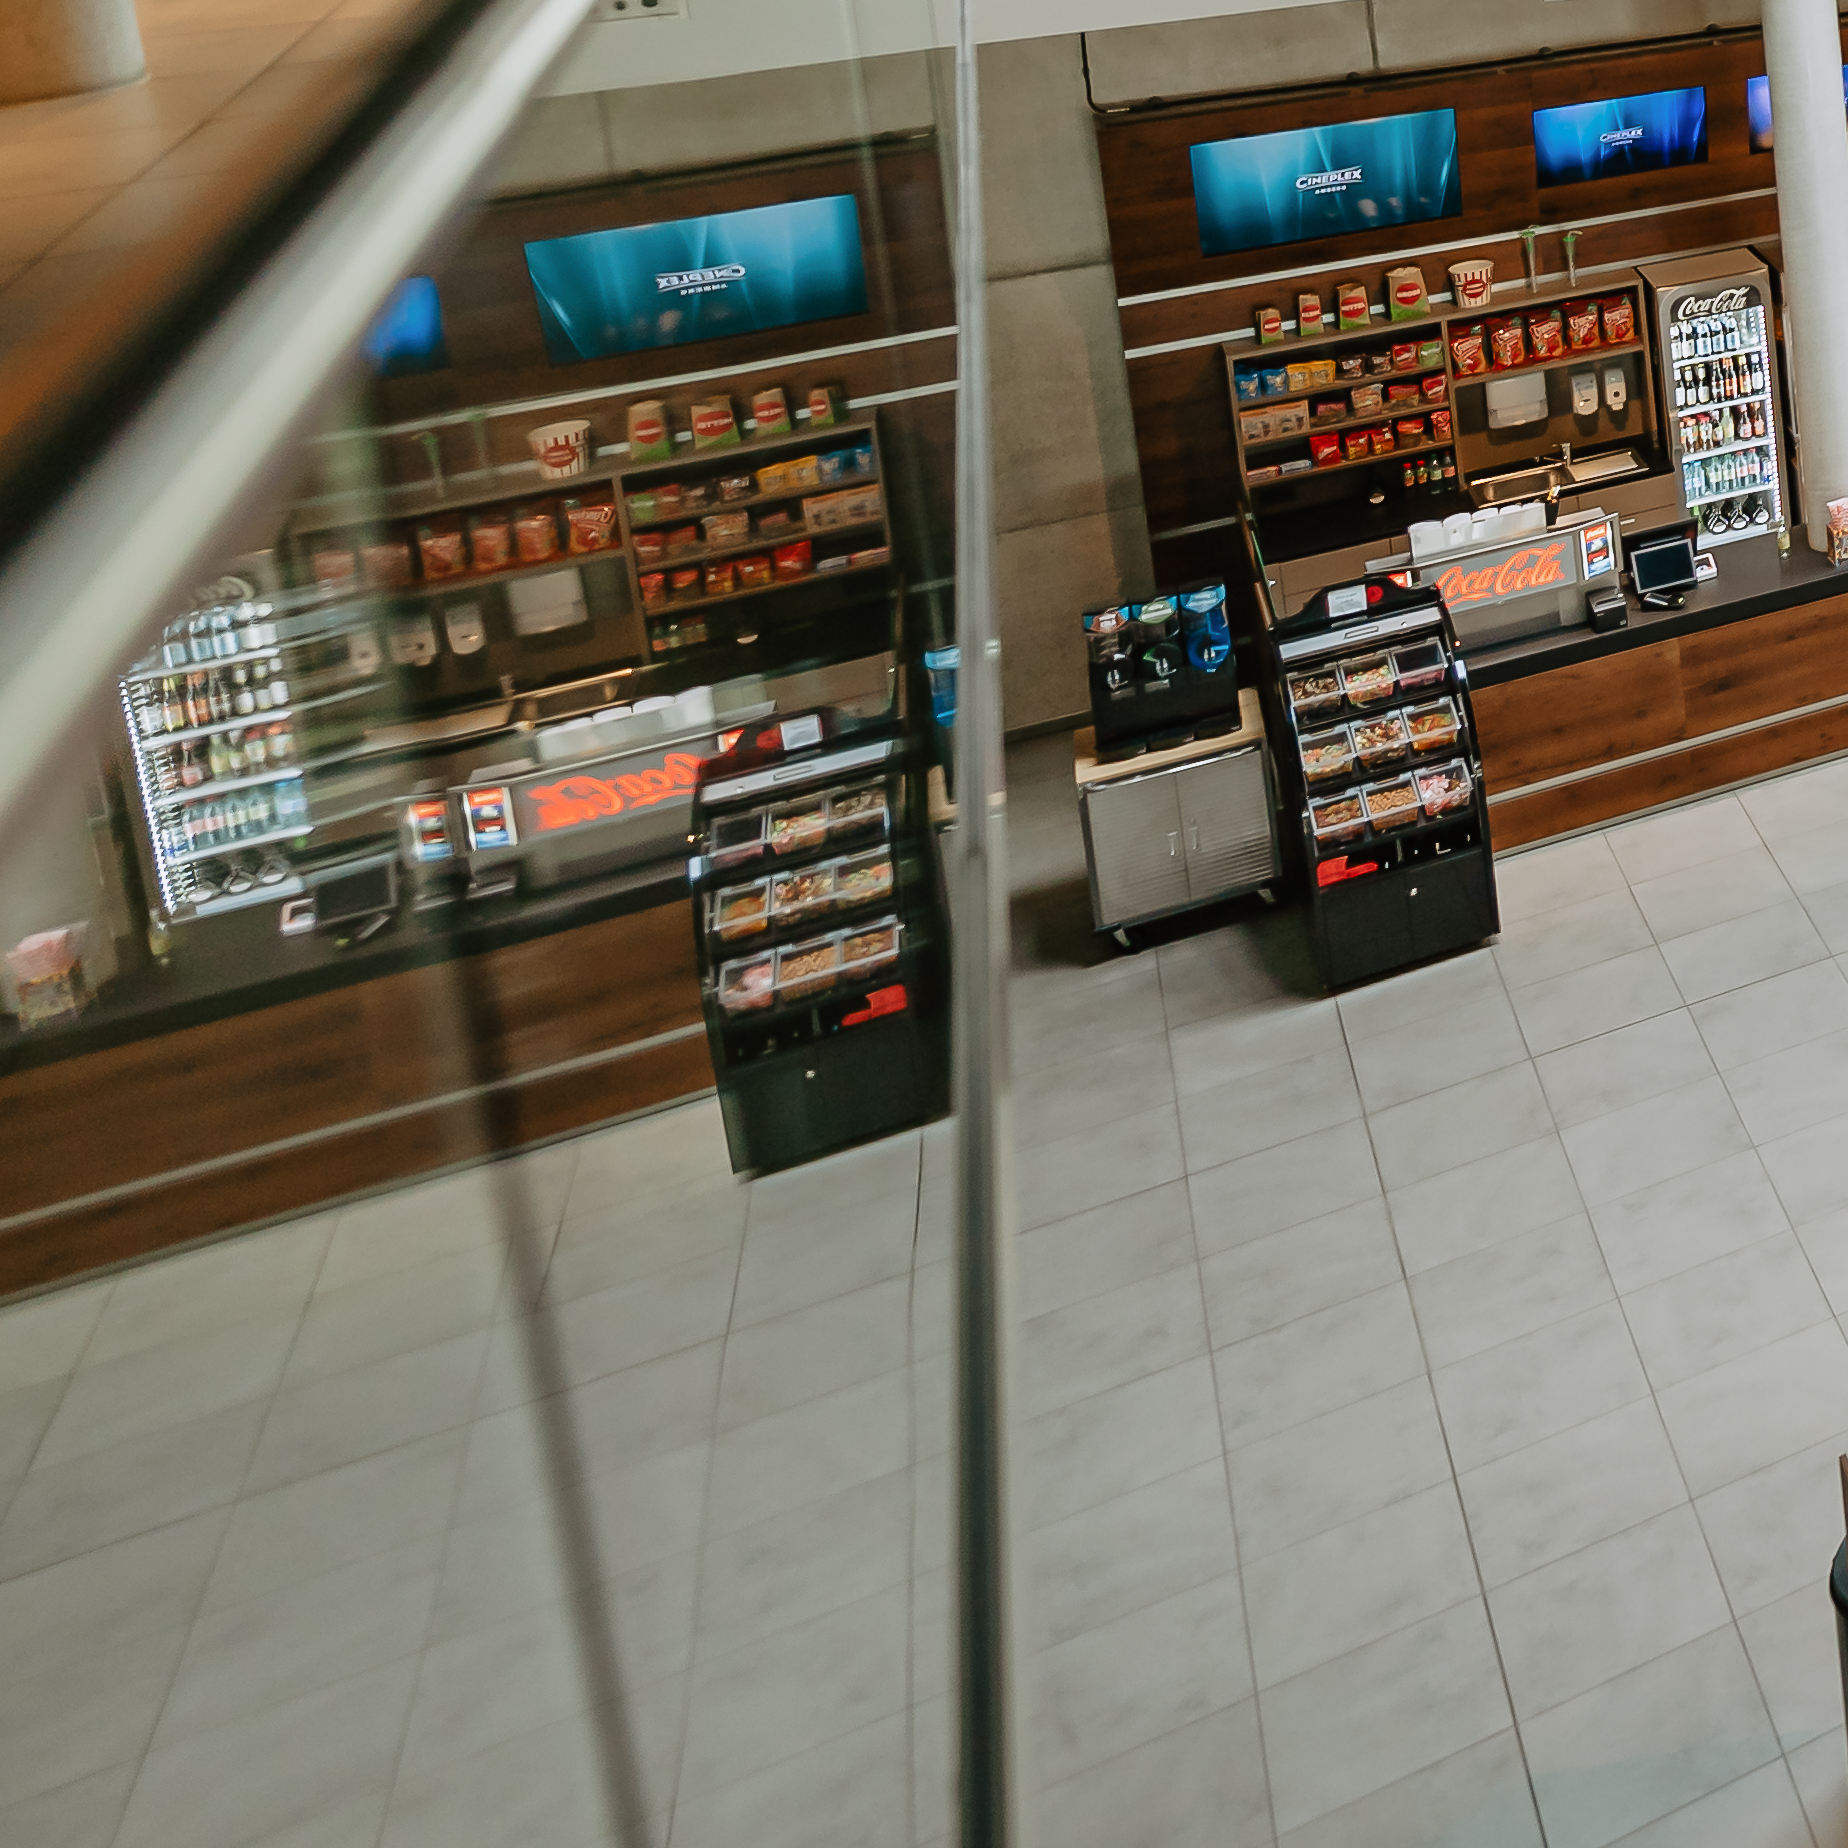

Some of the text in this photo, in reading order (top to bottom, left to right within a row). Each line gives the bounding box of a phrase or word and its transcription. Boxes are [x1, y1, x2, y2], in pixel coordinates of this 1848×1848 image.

[1295, 168, 1362, 189] CINEPLEX
[1677, 286, 1750, 320] Coca-Cola
[1435, 541, 1567, 609] Coca-Cola
